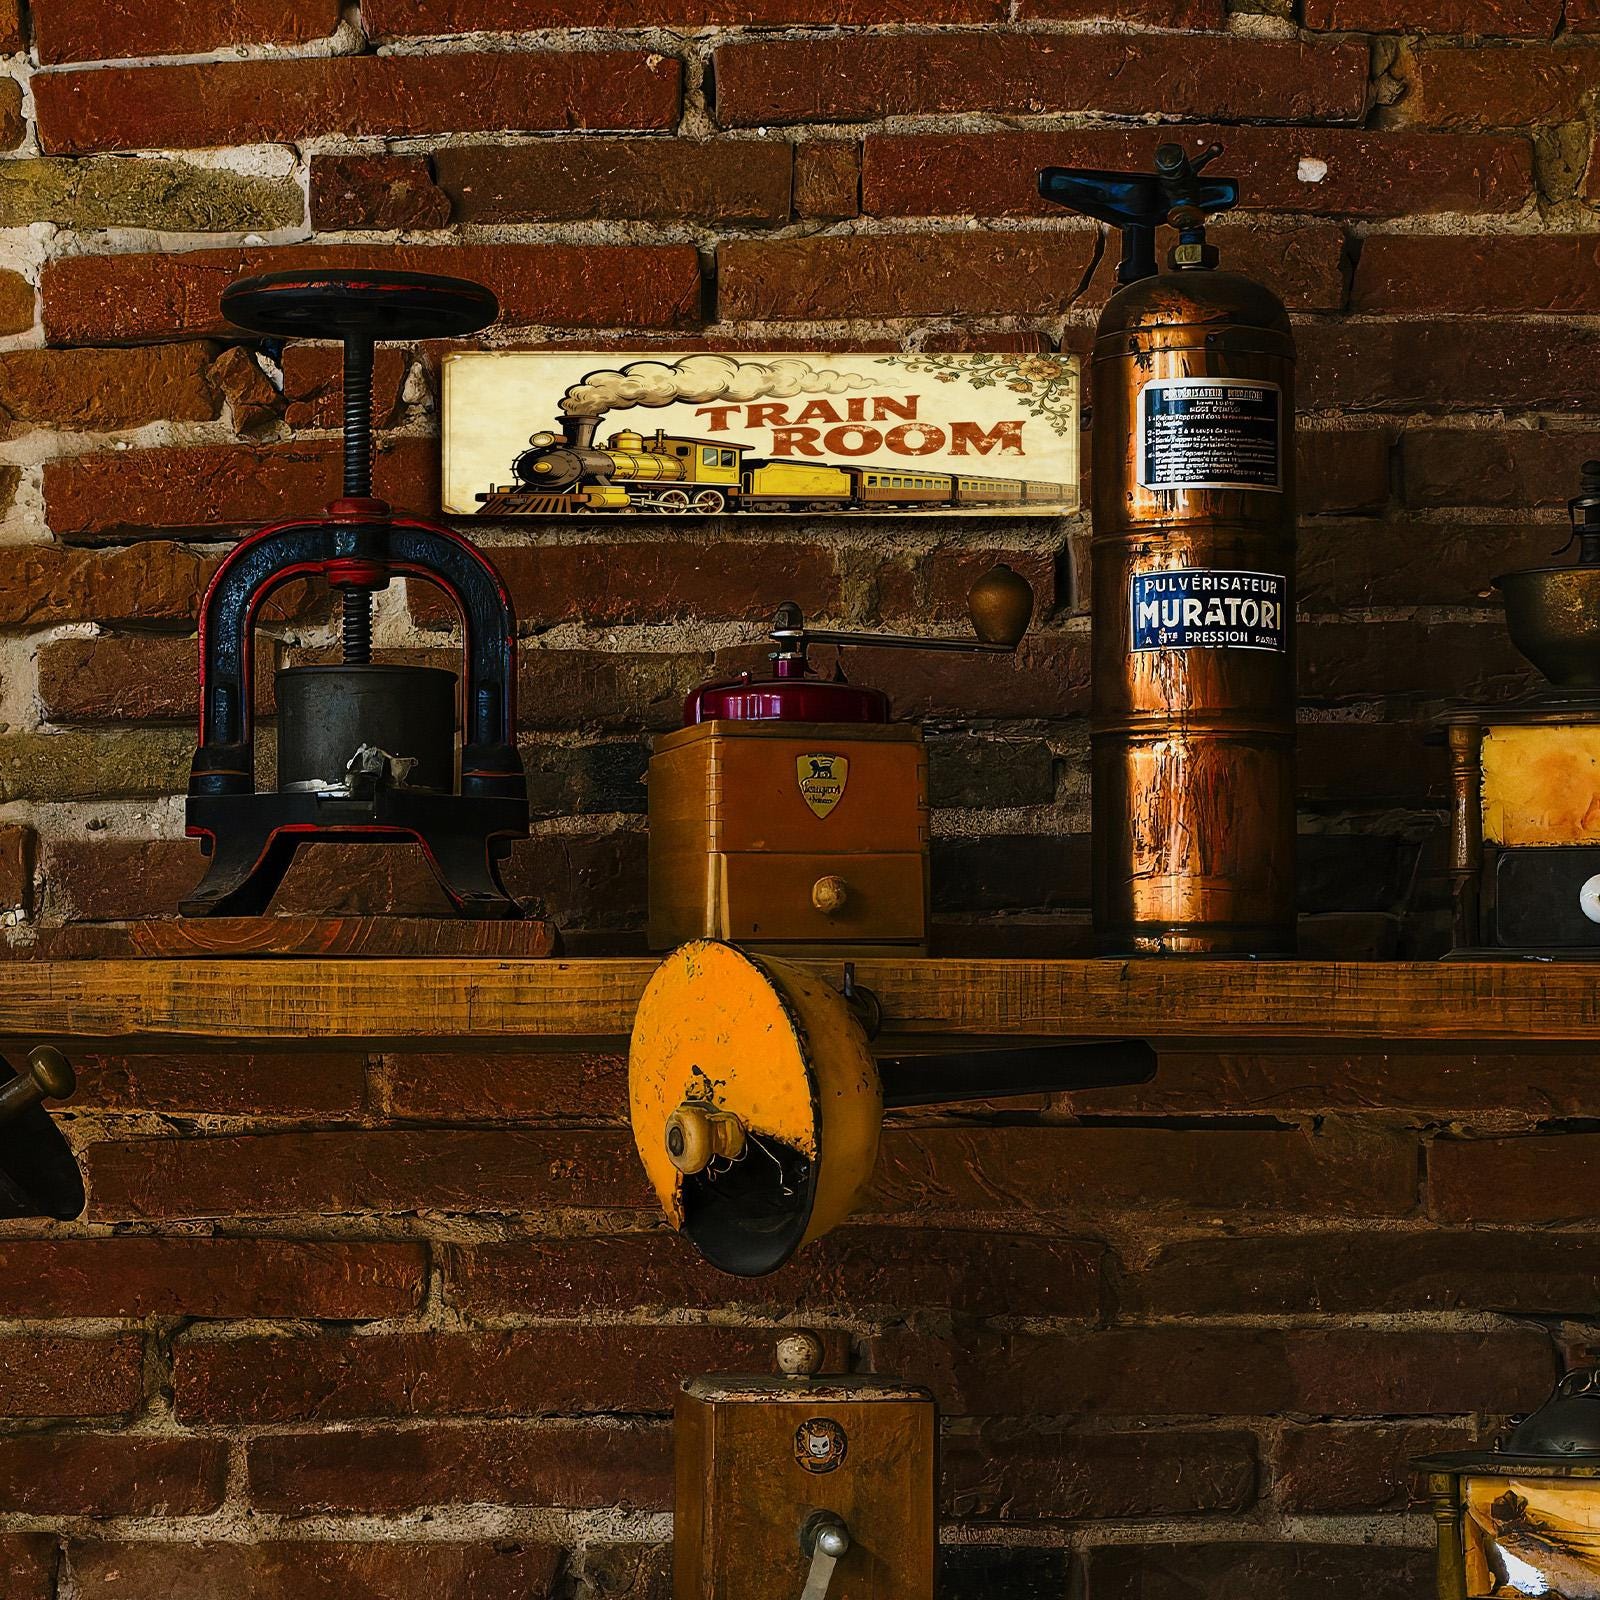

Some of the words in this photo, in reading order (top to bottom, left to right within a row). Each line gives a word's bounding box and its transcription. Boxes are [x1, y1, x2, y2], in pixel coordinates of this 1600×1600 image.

[694, 394, 921, 432] TRAIN
[768, 420, 1027, 457] ROOM
[1144, 574, 1278, 595] PULVÉRISATEUR
[1139, 597, 1281, 631] MURATORI
[1185, 631, 1248, 643] PRESSION
